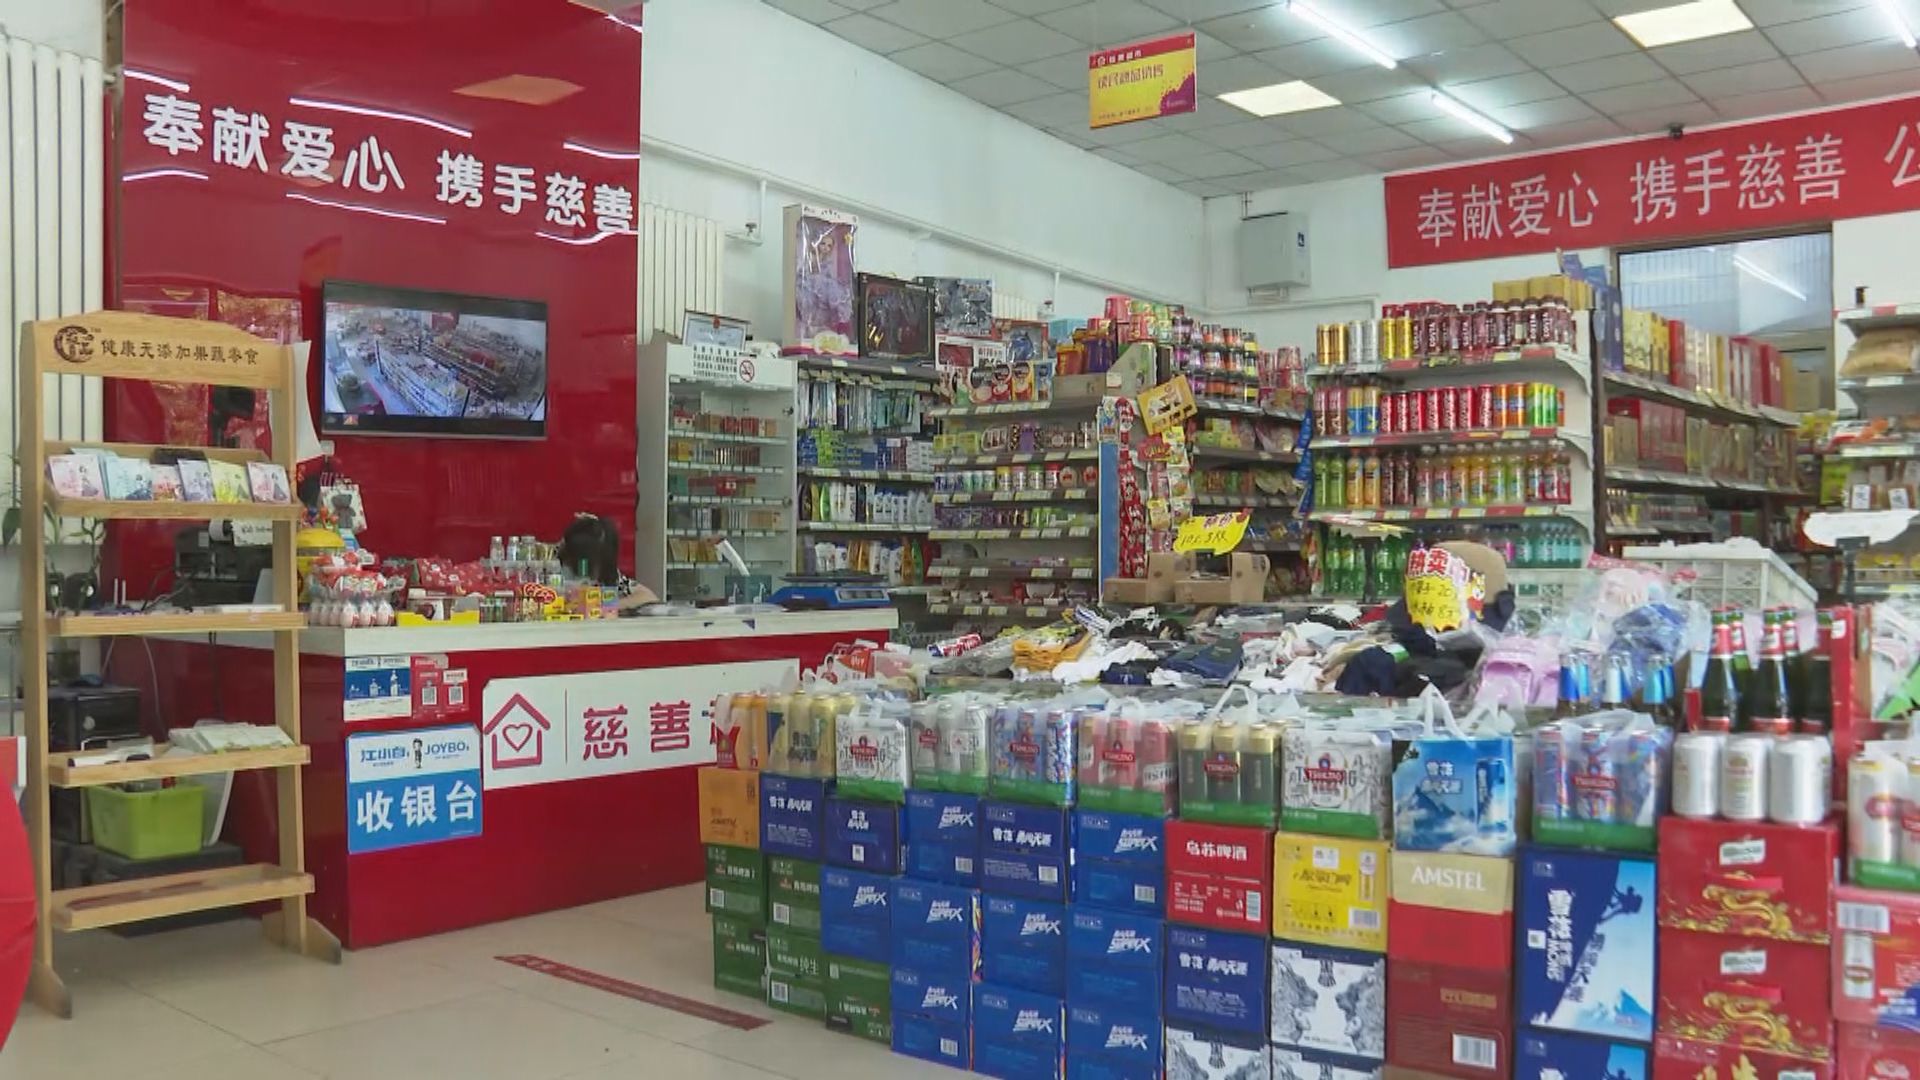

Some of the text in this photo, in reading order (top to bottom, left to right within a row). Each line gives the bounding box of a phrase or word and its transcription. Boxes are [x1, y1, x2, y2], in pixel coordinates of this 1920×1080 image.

[142, 93, 634, 233] 奉献爱心 携手慈善
[1416, 171, 1600, 248] 奉献爱心
[1629, 131, 1847, 224] 携手慈善
[100, 338, 259, 366] 健康无添加果蔬零食
[583, 699, 717, 761] 慈善
[360, 746, 405, 763] 江小白
[424, 741, 466, 756] JOYBO
[356, 780, 477, 834] 收银台
[1186, 840, 1247, 861] 乌苏啤酒
[1411, 864, 1487, 891] AMSTEL
